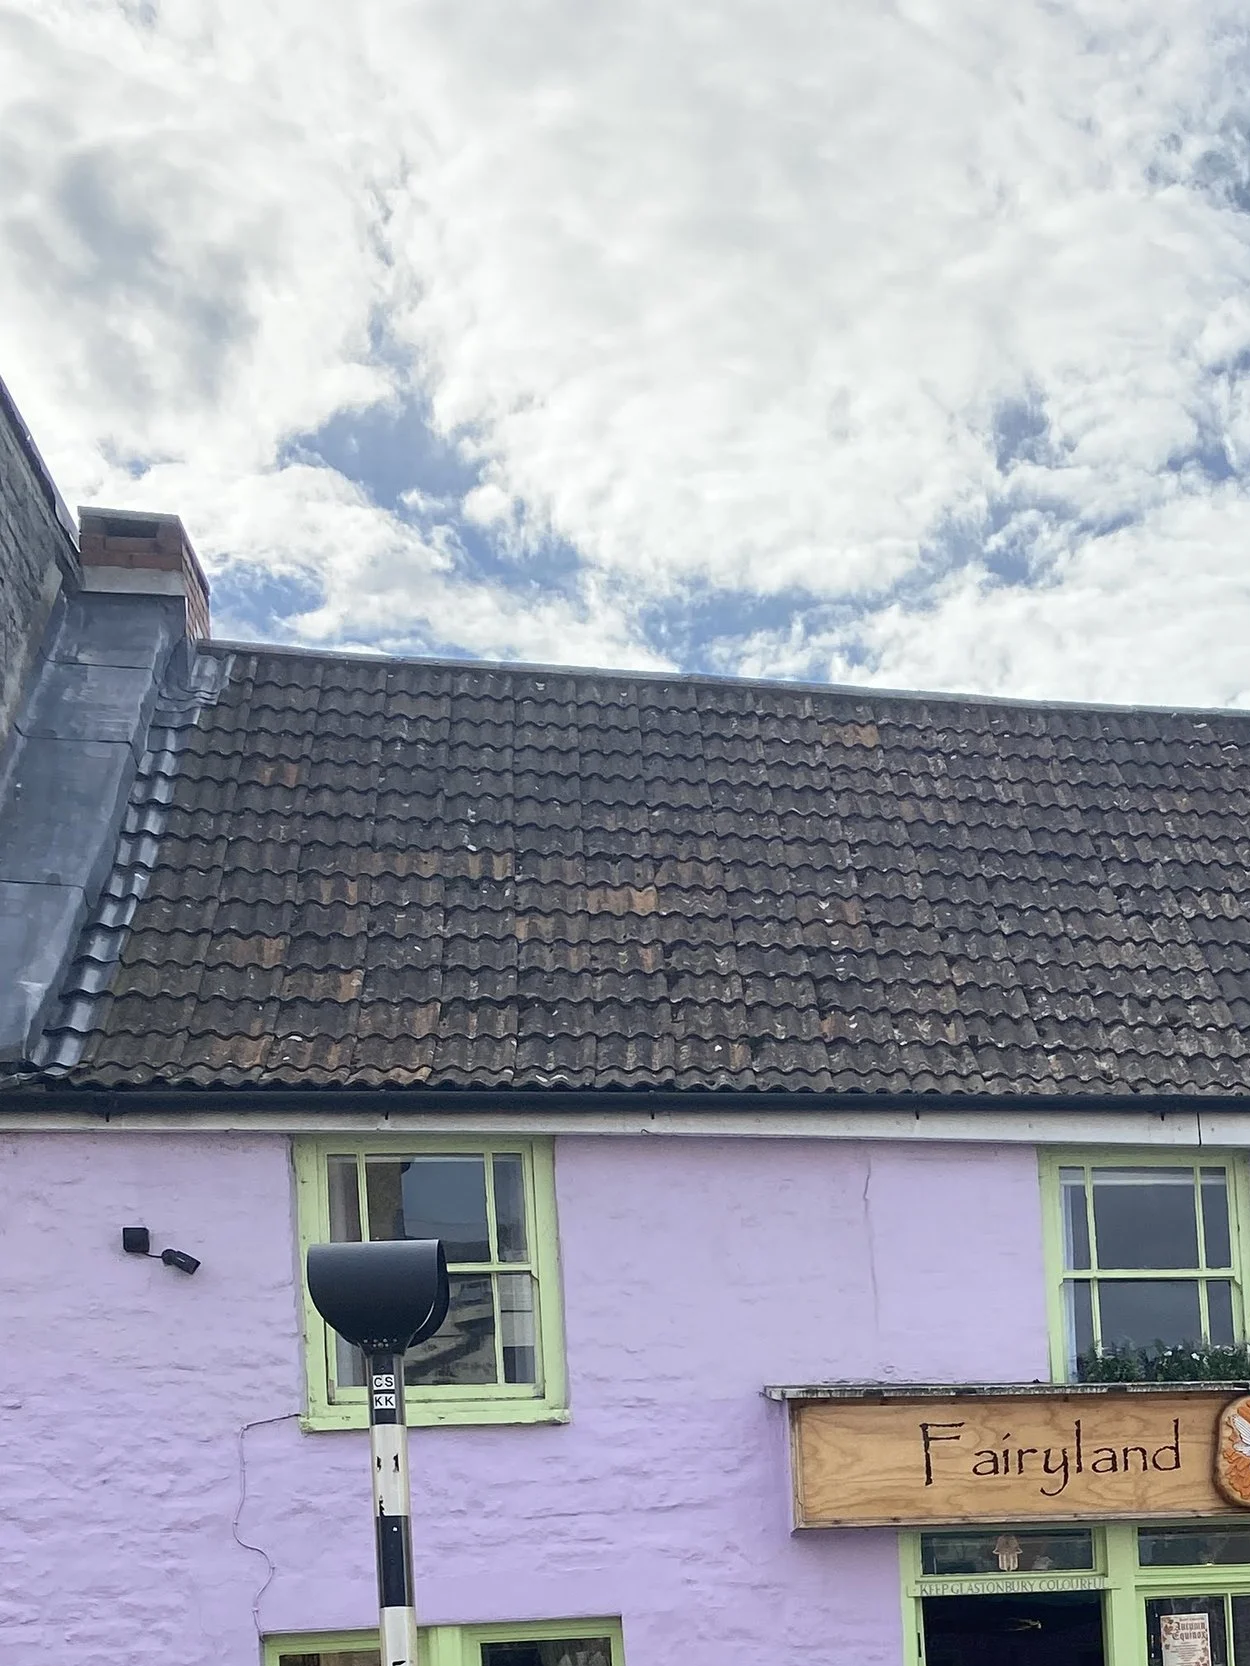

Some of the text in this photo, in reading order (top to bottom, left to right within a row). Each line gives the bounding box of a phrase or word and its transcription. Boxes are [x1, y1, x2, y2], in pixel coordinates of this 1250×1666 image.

[919, 1417, 1181, 1496] Fairyland
[950, 1579, 1035, 1595] GLASTONBURY
[1039, 1576, 1106, 1592] COLOURFUL
